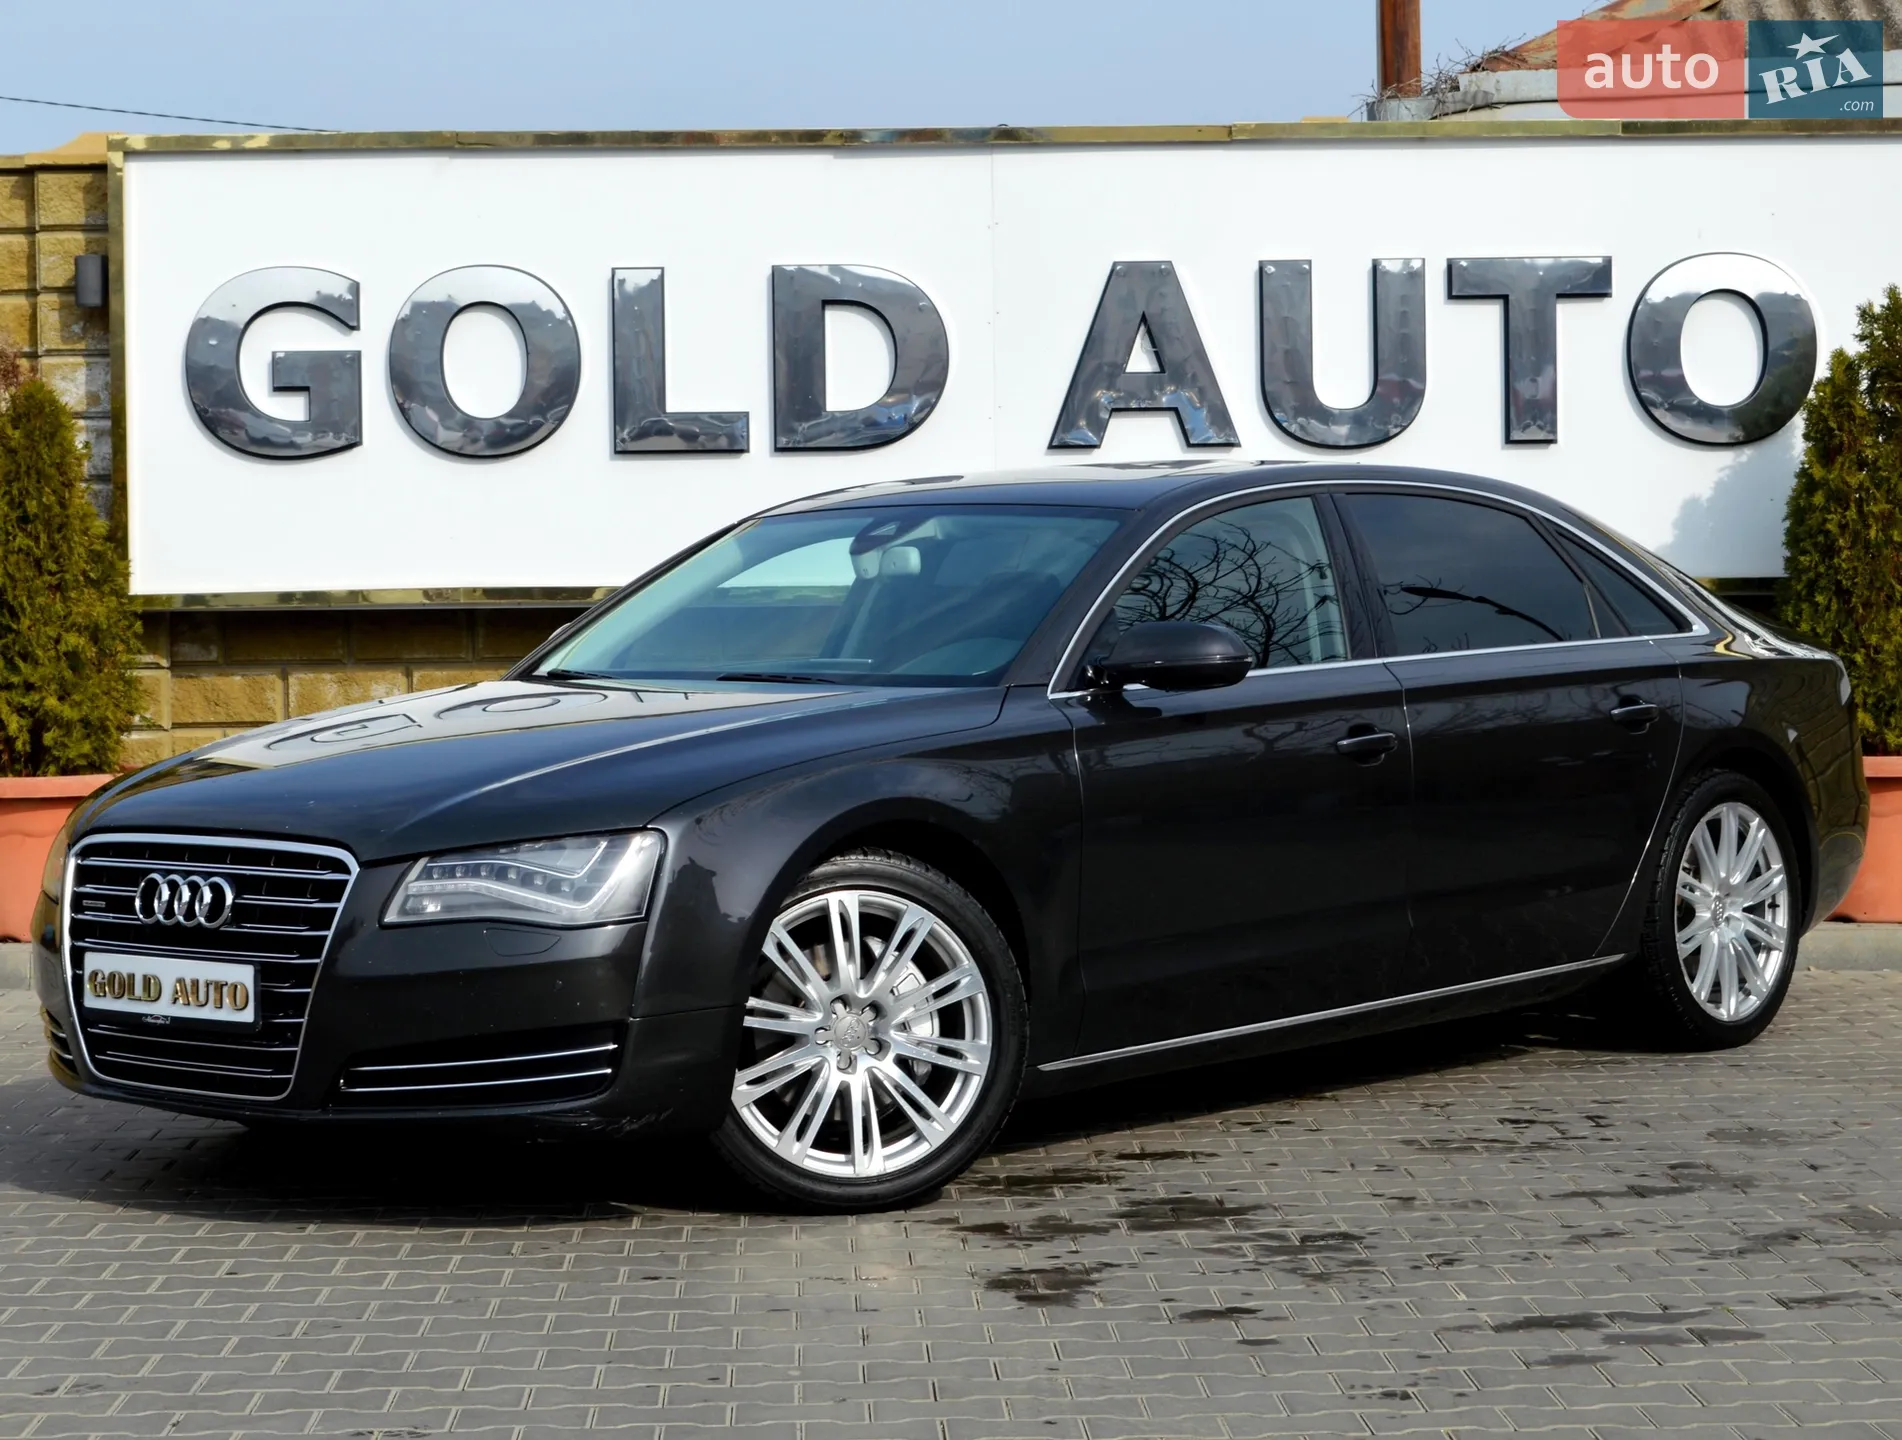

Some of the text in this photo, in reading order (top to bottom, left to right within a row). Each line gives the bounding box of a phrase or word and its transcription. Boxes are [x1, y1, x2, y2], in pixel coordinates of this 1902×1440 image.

[184, 252, 1818, 459] GOLD AUTO
[87, 969, 249, 1011] GOLD AUTO
